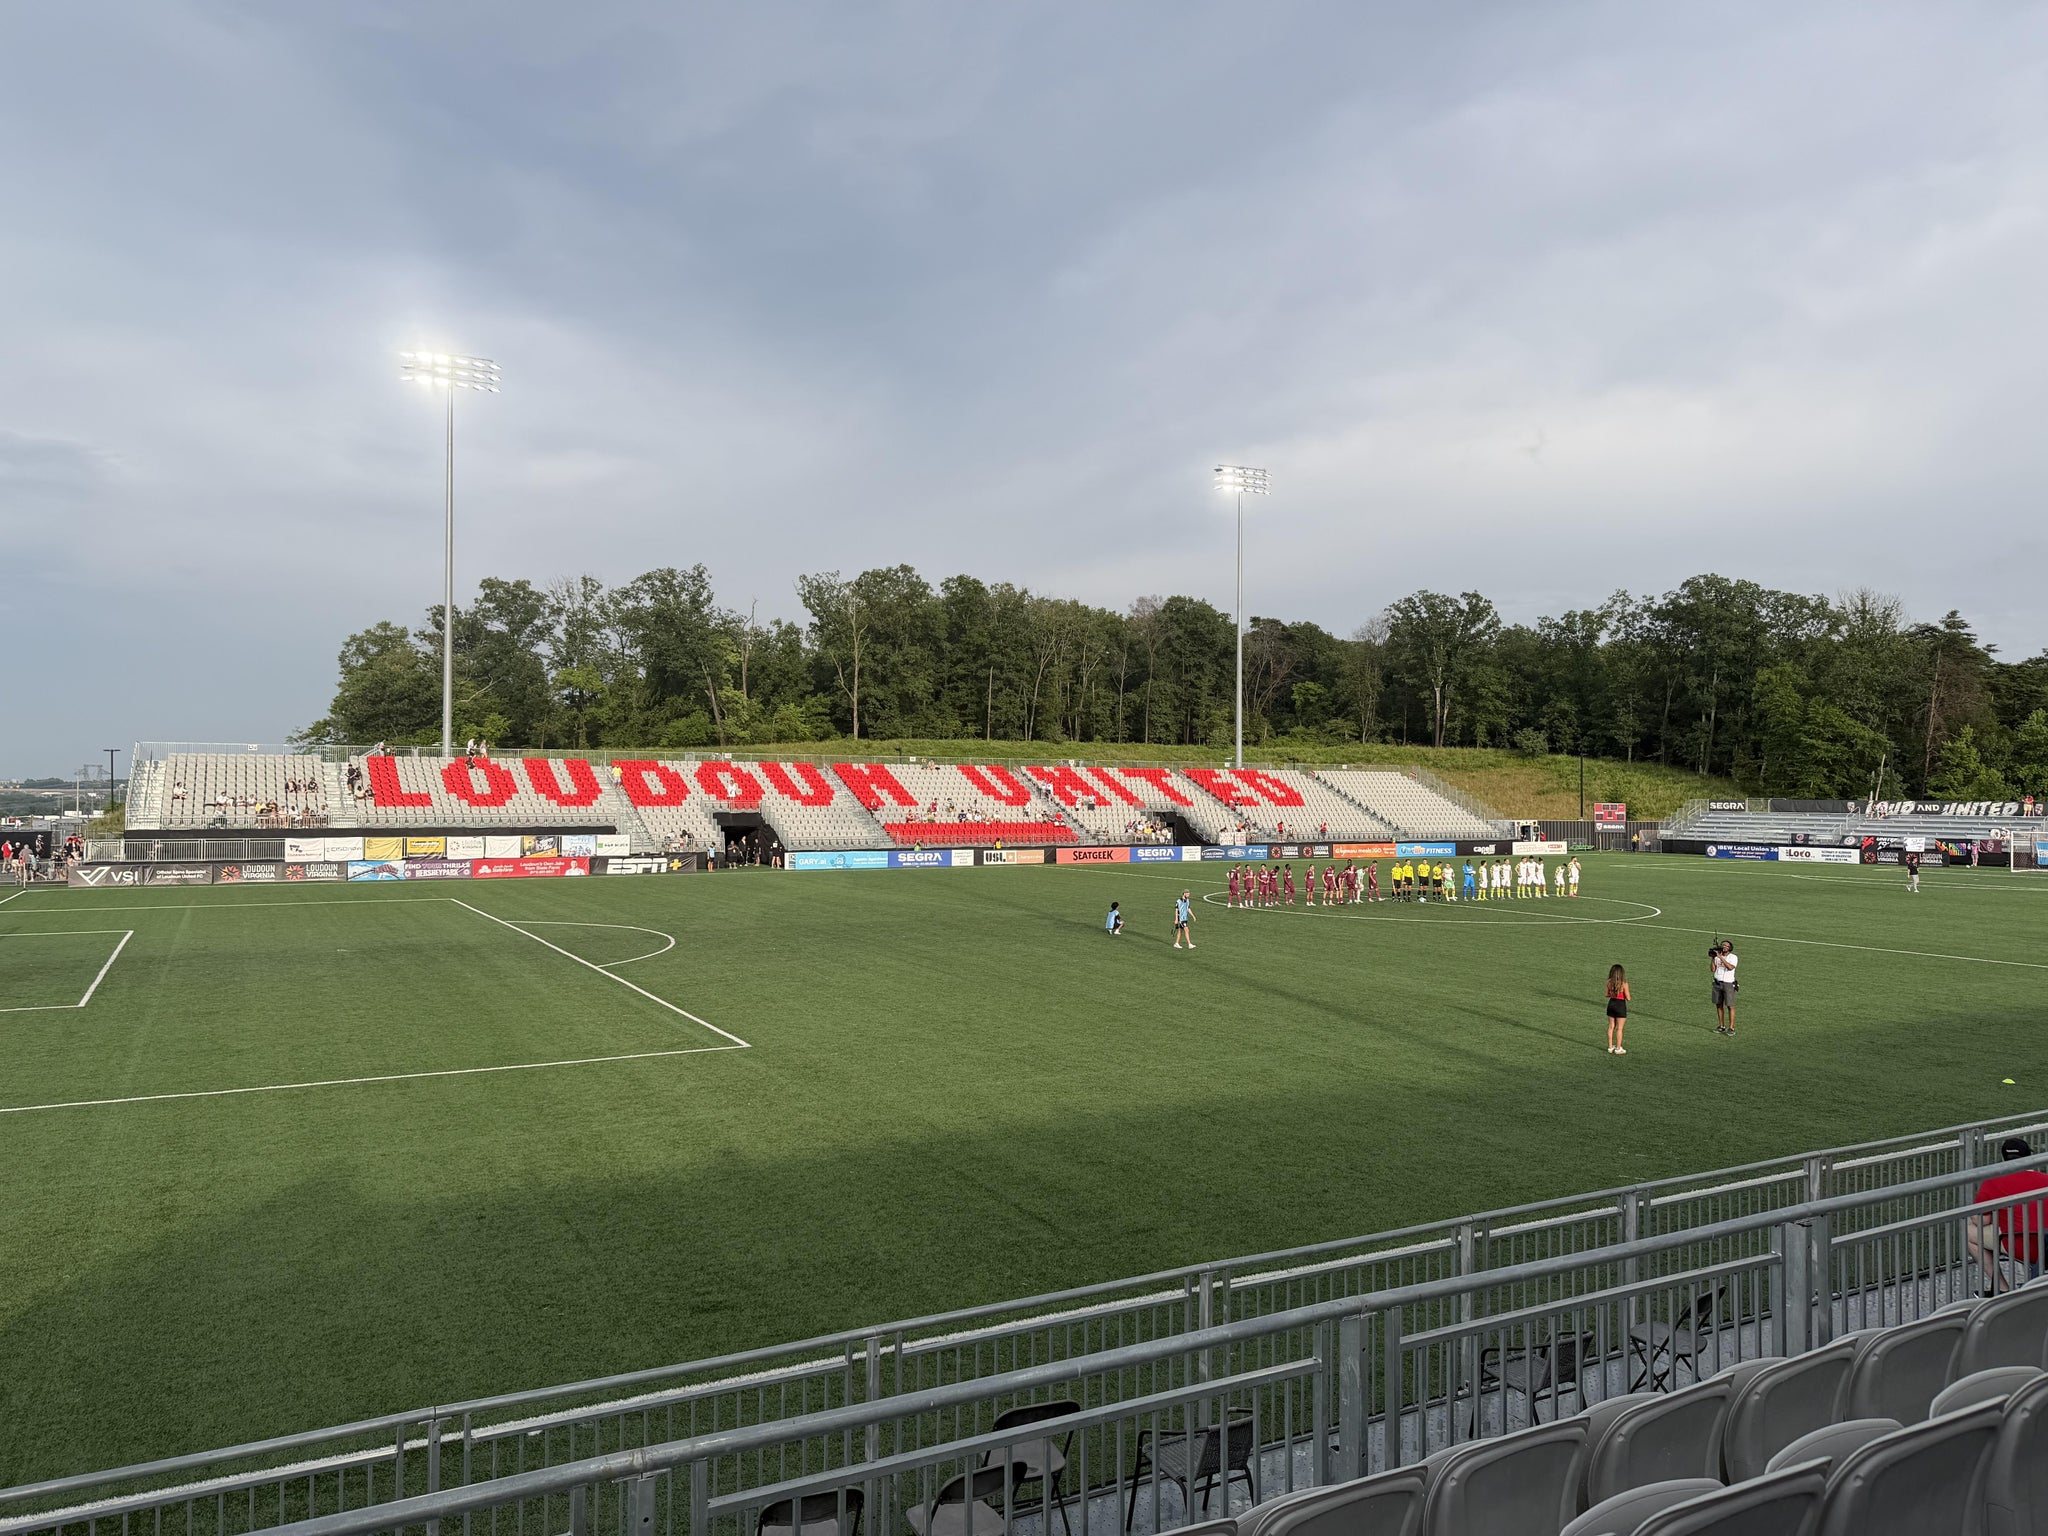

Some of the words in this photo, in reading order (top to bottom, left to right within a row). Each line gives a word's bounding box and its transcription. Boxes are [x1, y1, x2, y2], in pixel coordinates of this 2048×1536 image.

[366, 754, 918, 808] LOUDOUN
[957, 763, 1304, 808] UNITED
[1709, 802, 1745, 810] SEGRA
[1941, 801, 2019, 816] UNITED
[898, 853, 943, 862] SEGRA
[985, 852, 1006, 862] USL
[1073, 850, 1114, 860] SEATGEEK
[1137, 849, 1175, 857] SEGRA
[242, 864, 276, 873] LOUDOUN
[305, 863, 338, 871] LOUDOUN
[111, 871, 139, 881] VSI
[416, 869, 459, 877] HERSHEYPARK
